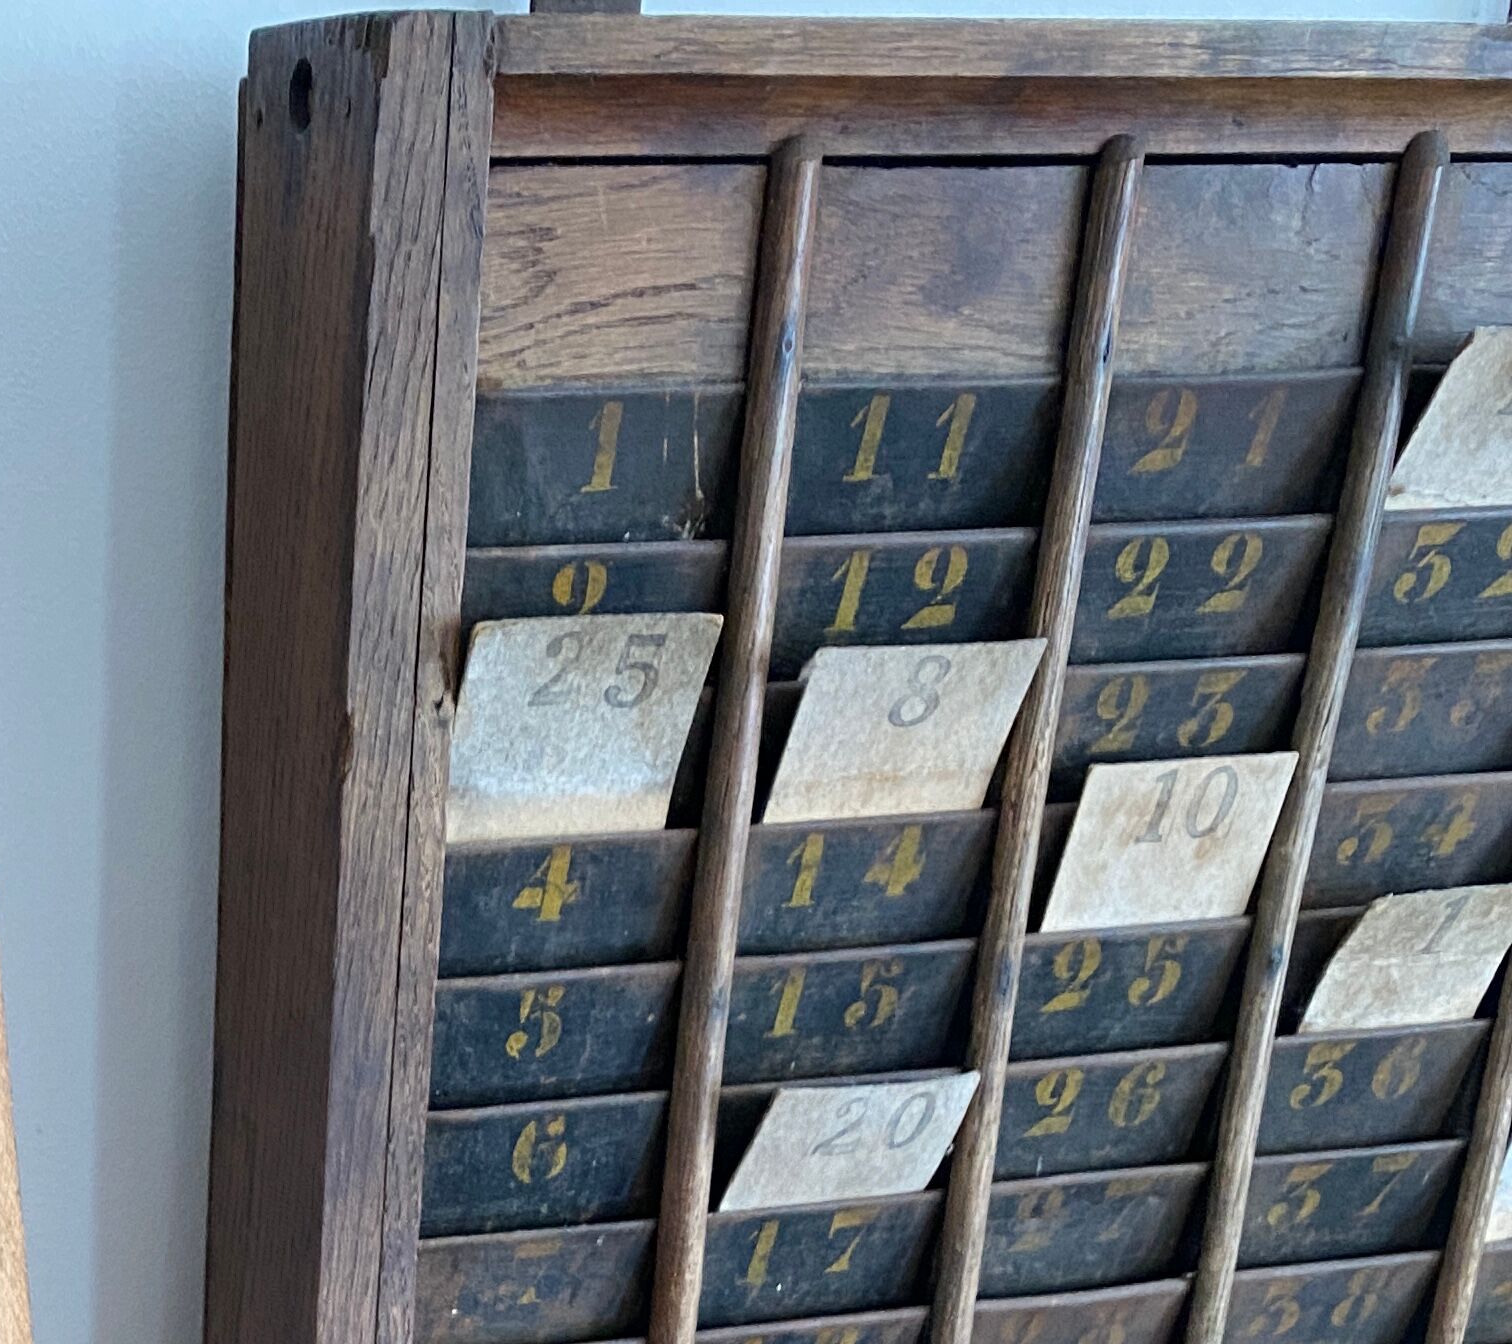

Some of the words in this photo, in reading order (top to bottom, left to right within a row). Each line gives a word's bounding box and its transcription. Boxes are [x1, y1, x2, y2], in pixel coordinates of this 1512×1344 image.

[580, 400, 624, 494] 1
[841, 393, 977, 483] 11
[824, 546, 969, 634] 12
[1106, 533, 1264, 620] 22
[527, 630, 668, 709] 25
[888, 655, 952, 728] 8
[1090, 669, 1248, 754] 23
[1134, 764, 1240, 844] 10
[512, 844, 581, 922] 4
[783, 825, 926, 909] 14
[763, 958, 905, 1039] 15
[1040, 934, 1190, 1014] 25
[506, 985, 566, 1059] 5
[810, 1089, 938, 1157] 20
[1020, 1061, 1167, 1139] 26
[511, 1115, 568, 1184] 6
[1266, 1152, 1421, 1227] 37
[743, 1206, 882, 1291] 17
